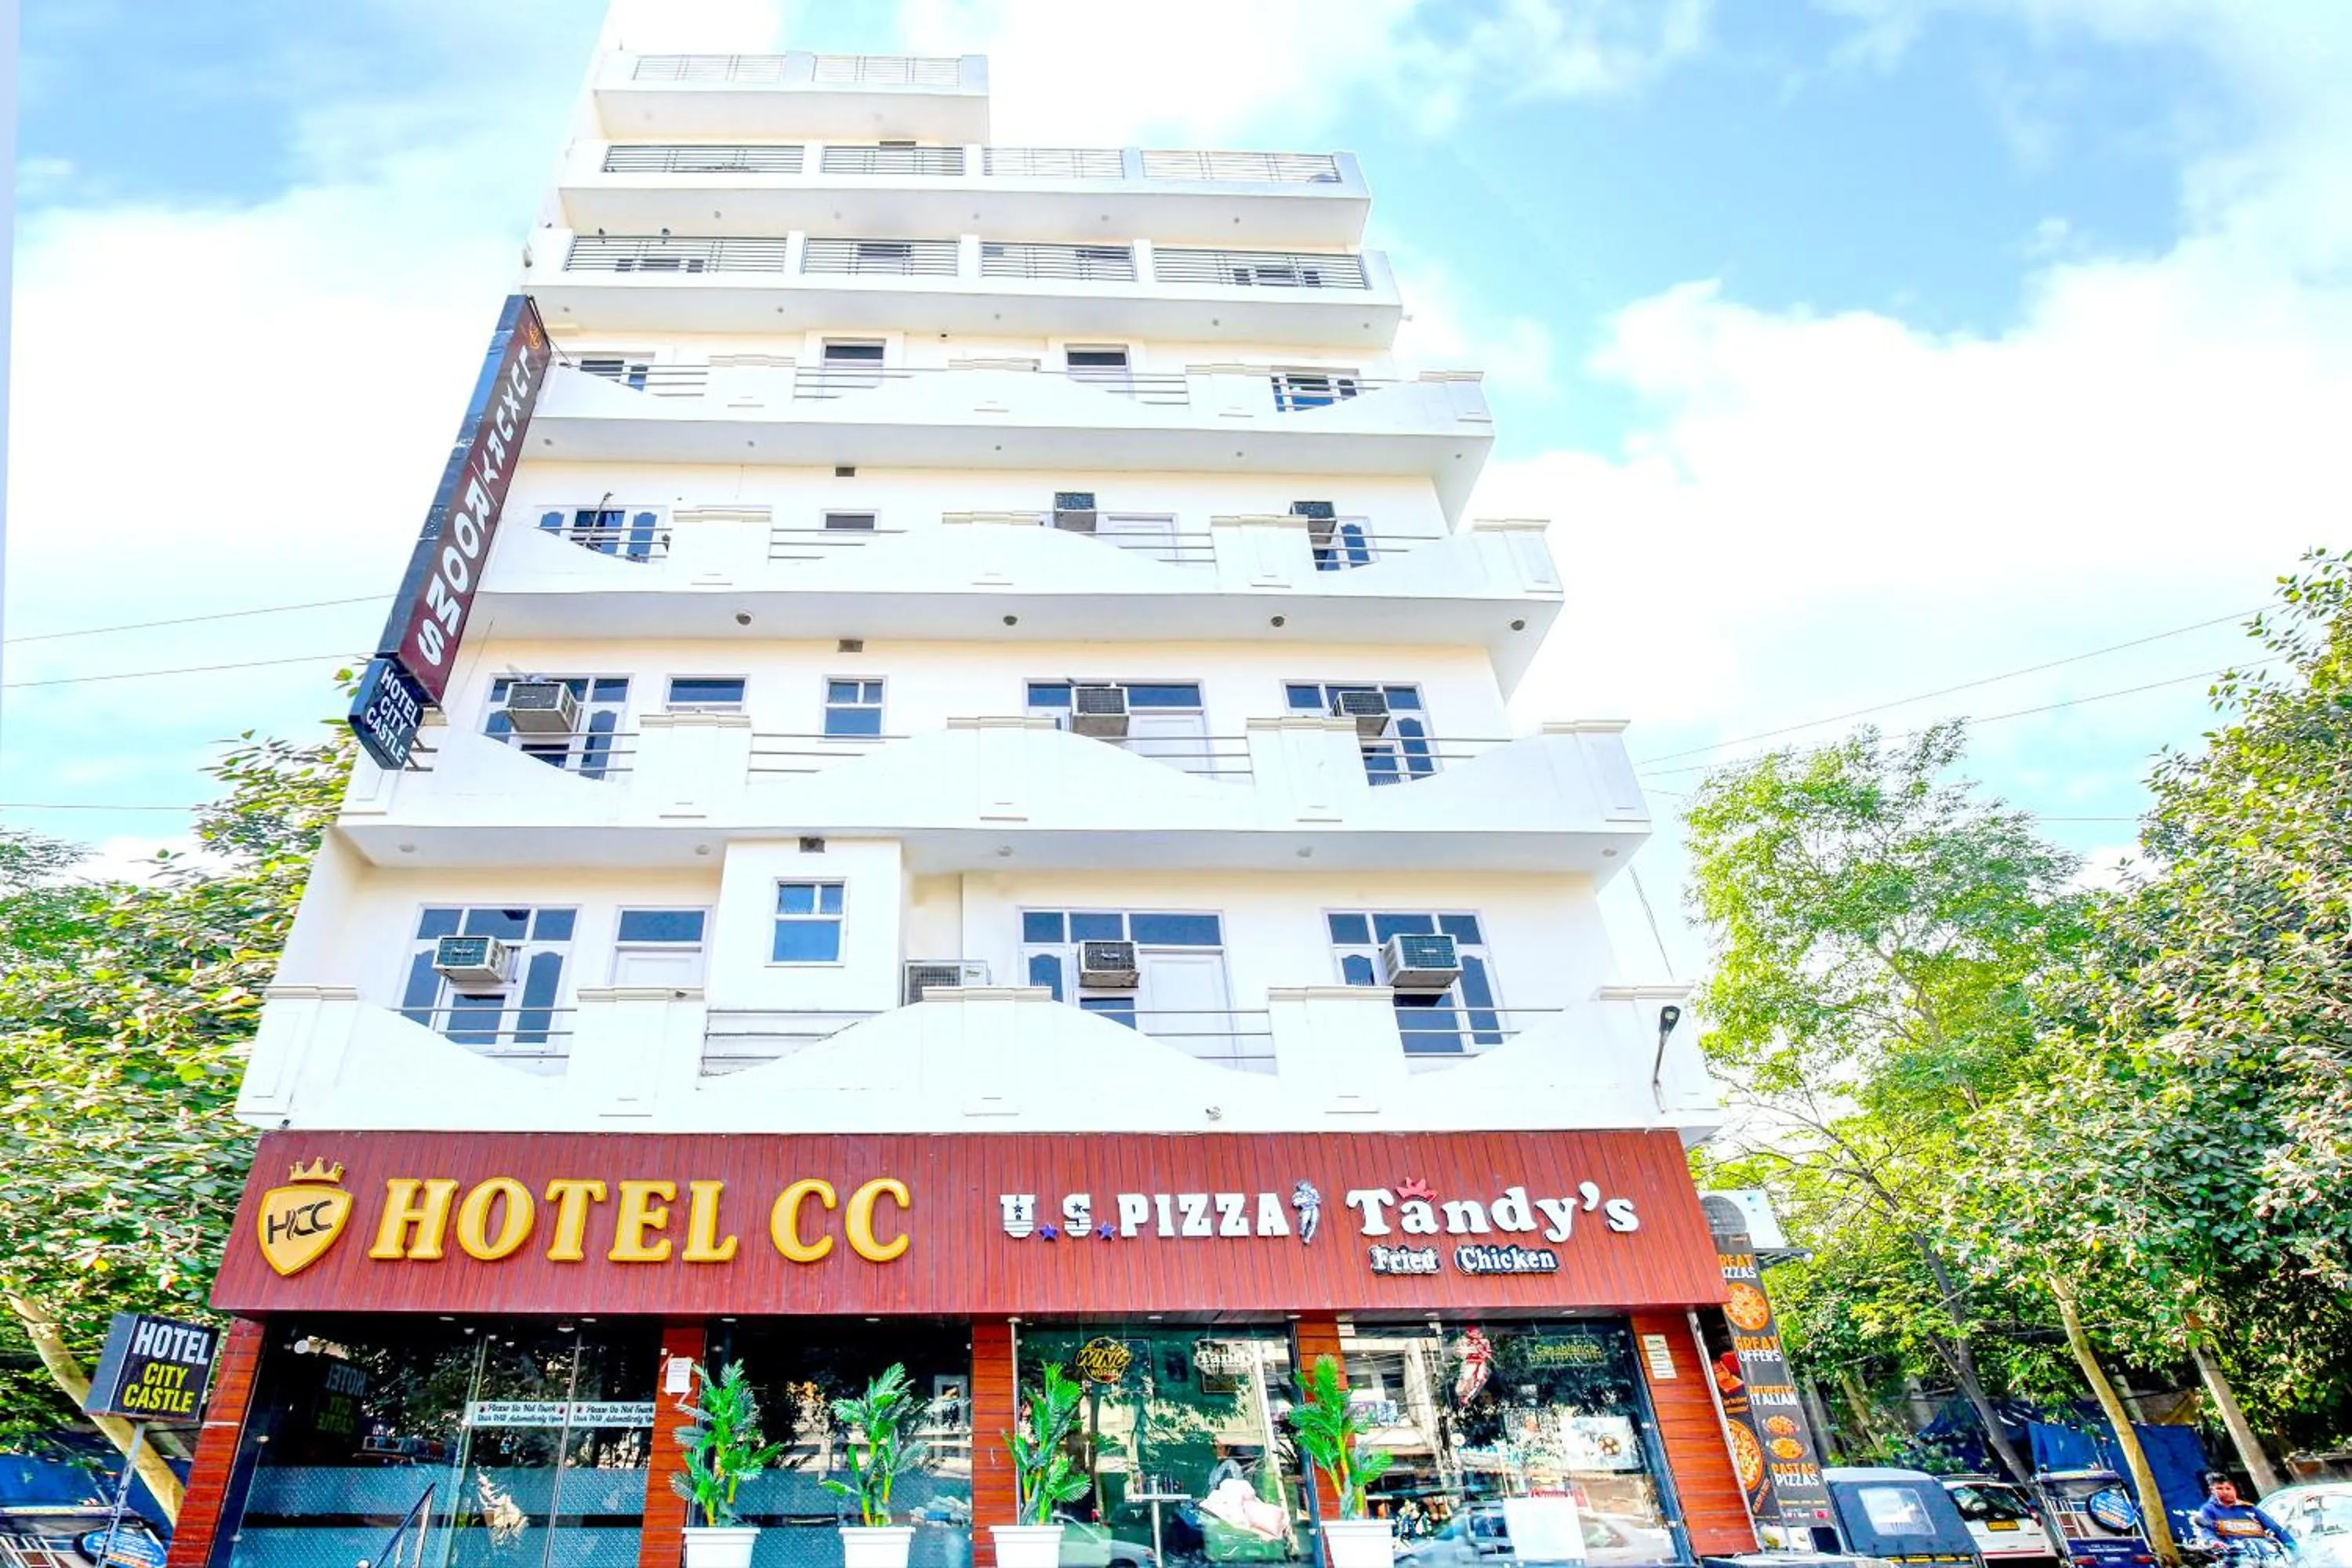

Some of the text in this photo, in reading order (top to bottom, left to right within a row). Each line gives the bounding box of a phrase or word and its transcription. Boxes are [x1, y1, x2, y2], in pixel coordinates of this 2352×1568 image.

[380, 666, 417, 728] HOTEL
[380, 696, 408, 735] CITY
[366, 707, 405, 763] CASTLE
[368, 1177, 911, 1263] HOTEL CC
[1345, 1181, 1639, 1243] Tandy's
[1370, 1245, 1557, 1274] Fried Chicken
[1718, 1254, 1753, 1267] REAT
[1722, 1266, 1757, 1279] IZZAS
[132, 1321, 210, 1364] HOTEL
[1733, 1336, 1779, 1351] GREAT
[1737, 1349, 1783, 1361] OFFERS
[143, 1362, 188, 1388] CITY
[123, 1384, 195, 1413] CASTLE
[1774, 1473, 1820, 1487] PIZZAS
